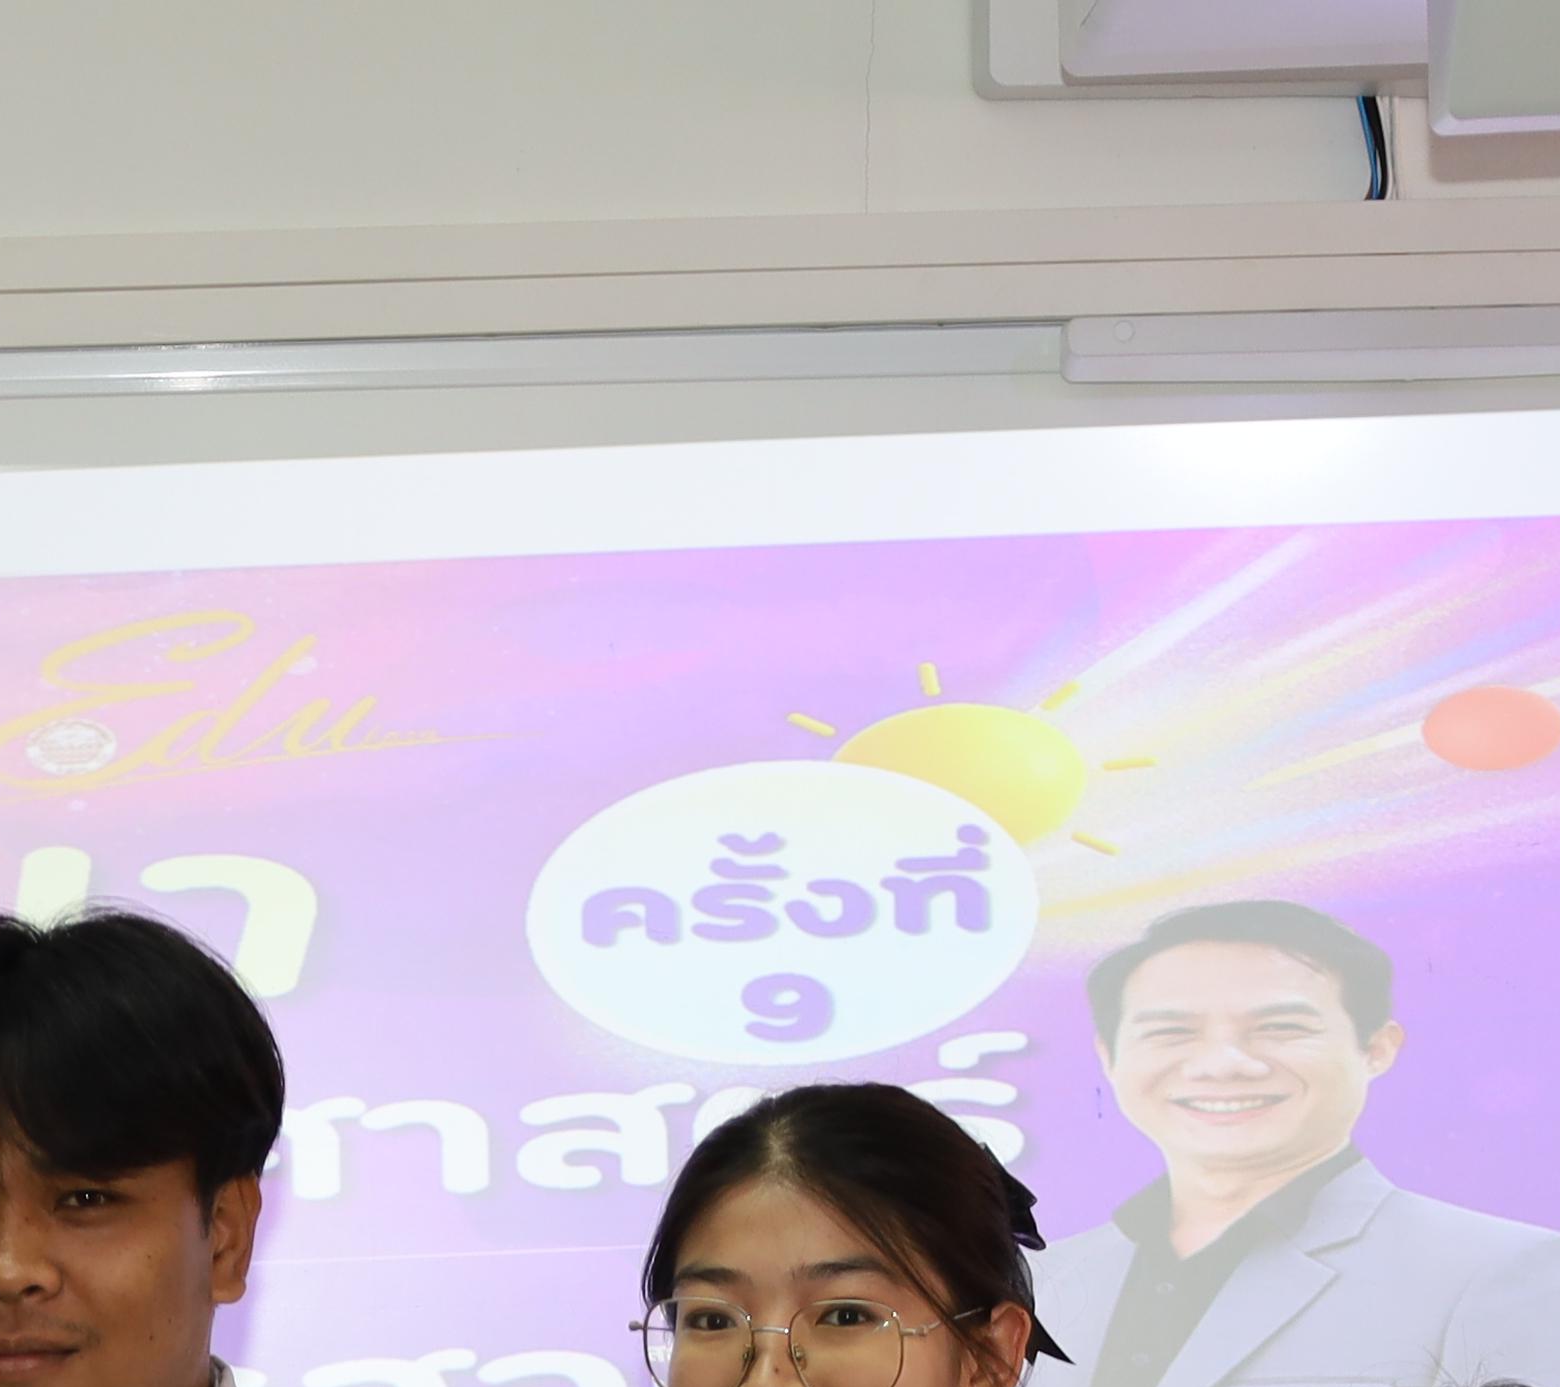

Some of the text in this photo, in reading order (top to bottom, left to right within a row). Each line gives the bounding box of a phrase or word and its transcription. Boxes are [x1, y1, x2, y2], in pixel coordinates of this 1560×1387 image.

[580, 822, 994, 950] ครั้งที่
[739, 972, 836, 1044] 9
